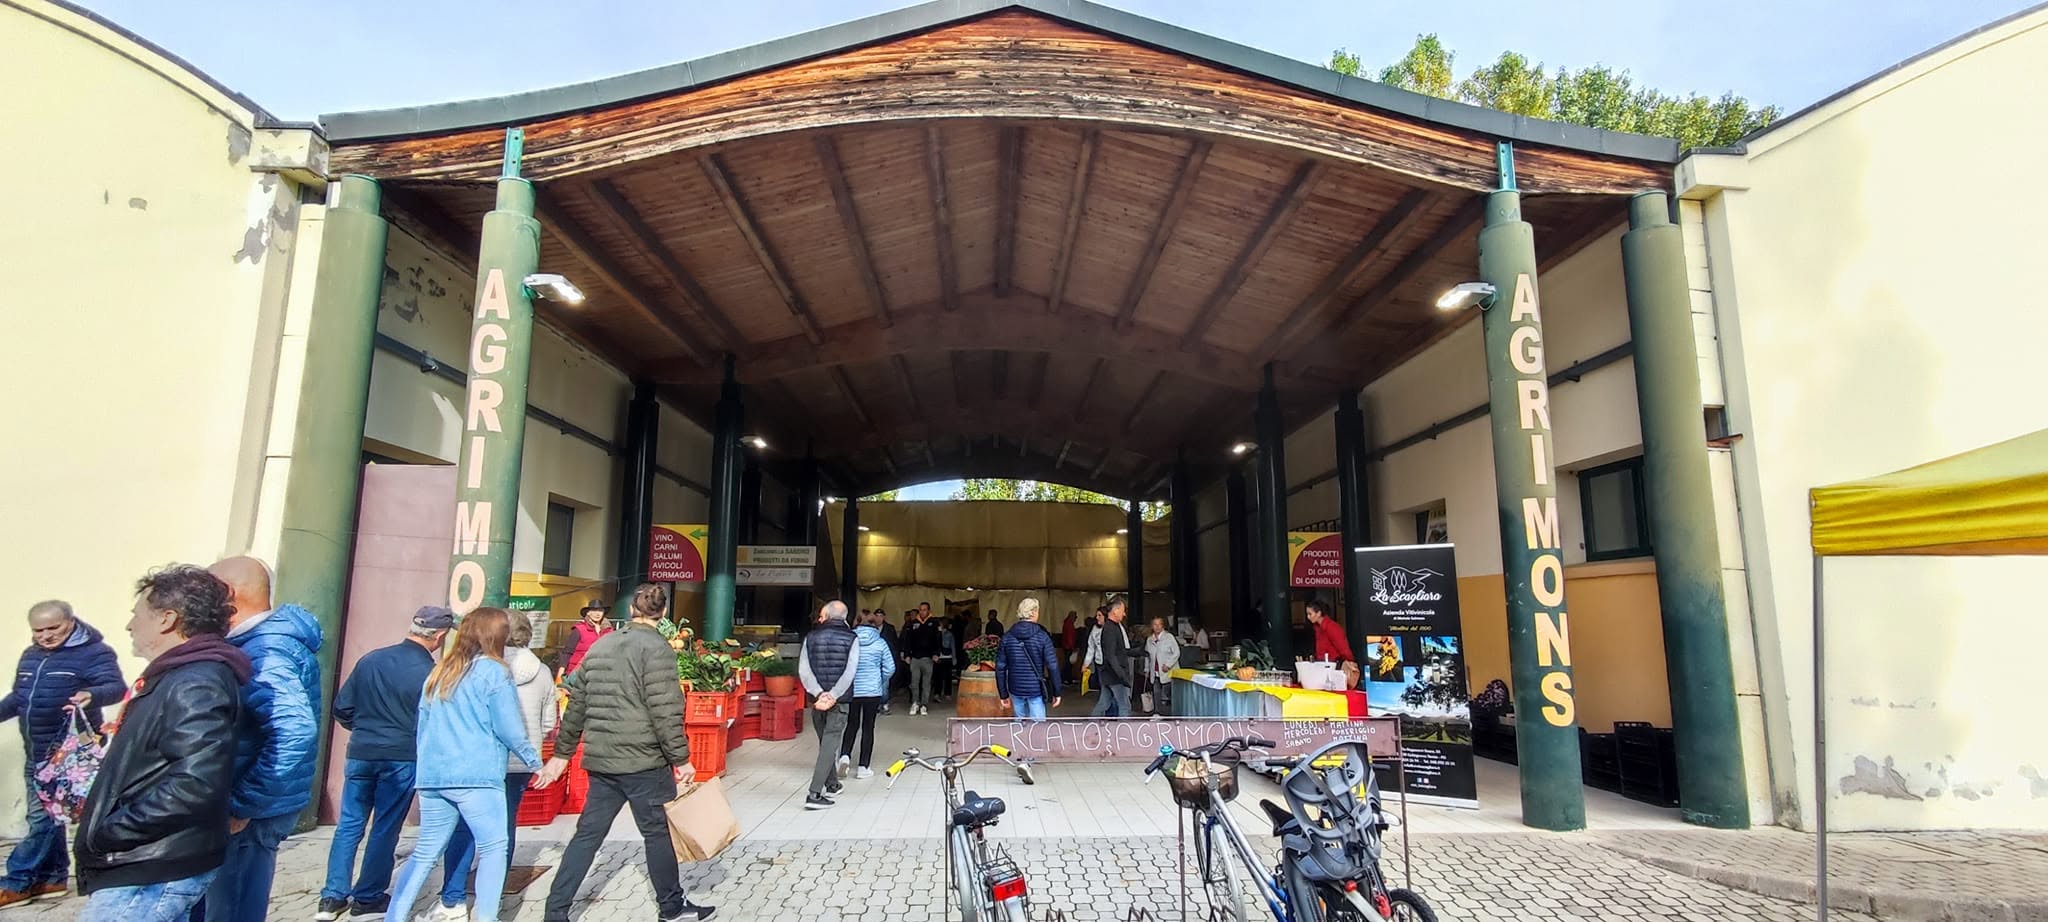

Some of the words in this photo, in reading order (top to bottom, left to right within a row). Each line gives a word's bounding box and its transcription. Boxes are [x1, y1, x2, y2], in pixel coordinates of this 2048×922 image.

[1509, 274, 1575, 728] AGRIMONS
[1305, 577, 1341, 585] CONIGLIO
[1370, 589, 1389, 605] La
[1389, 589, 1443, 607] Scagliara
[1405, 608, 1435, 616] Vitivinicola
[1330, 720, 1364, 729] MATTINA
[962, 722, 1101, 752] MERCATO
[1285, 737, 1312, 748] SABATO
[1333, 734, 1368, 742] MATTINA
